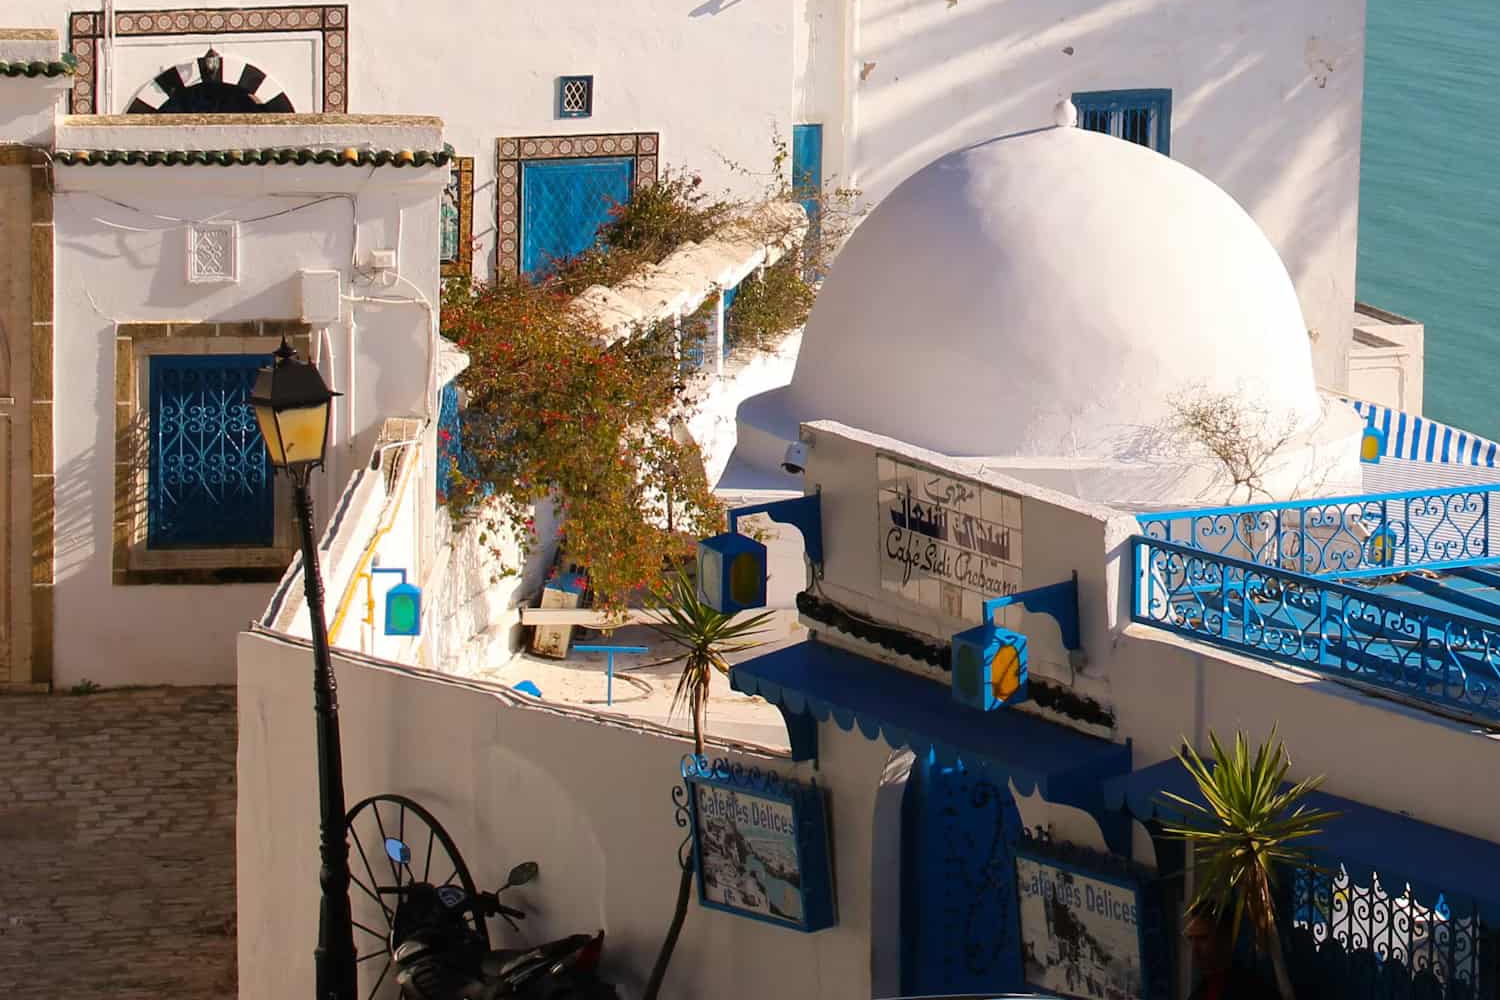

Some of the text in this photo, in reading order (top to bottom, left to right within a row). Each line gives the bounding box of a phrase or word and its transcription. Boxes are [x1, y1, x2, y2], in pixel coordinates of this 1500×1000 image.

[886, 527, 919, 586] Café
[920, 543, 952, 578] Sidi
[751, 801, 794, 834] Délices
[1086, 883, 1137, 925] Délices
